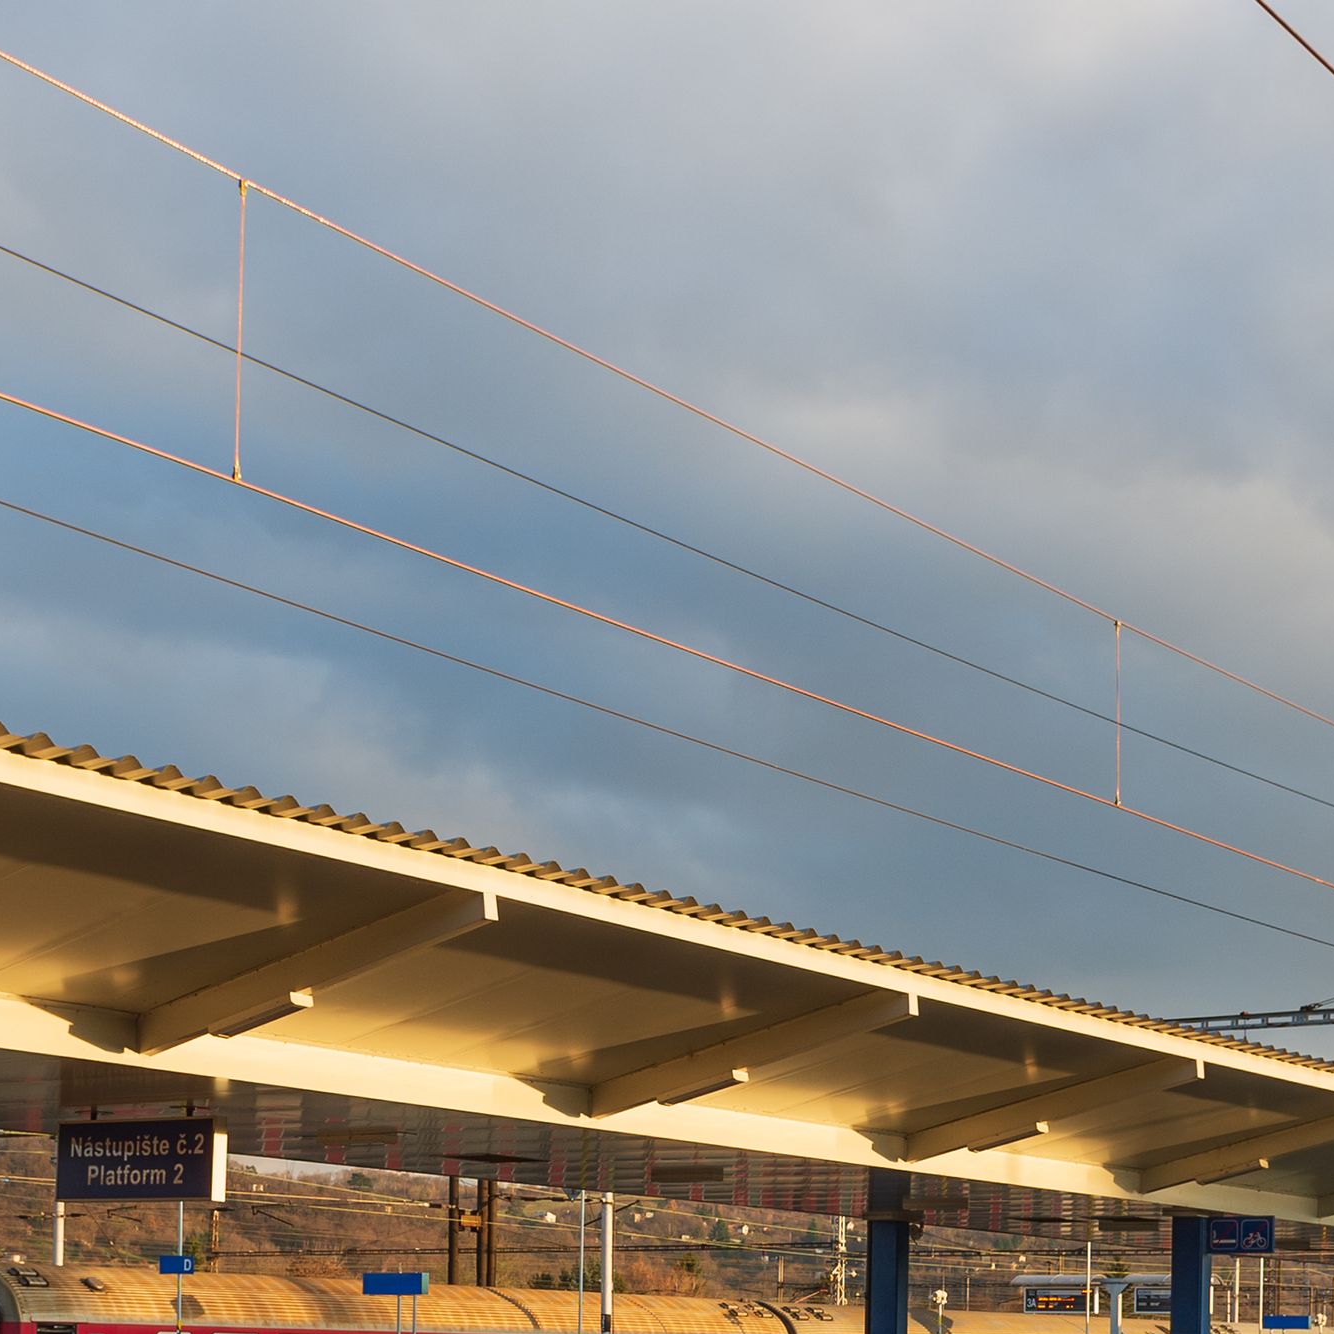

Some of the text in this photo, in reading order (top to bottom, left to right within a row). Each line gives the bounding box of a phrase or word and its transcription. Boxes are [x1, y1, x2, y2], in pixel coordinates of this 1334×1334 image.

[70, 1133, 204, 1161] Nástupište č.2
[87, 1163, 184, 1186] Platform 2
[184, 1259, 192, 1271] D
[1027, 1298, 1037, 1307] 3A
